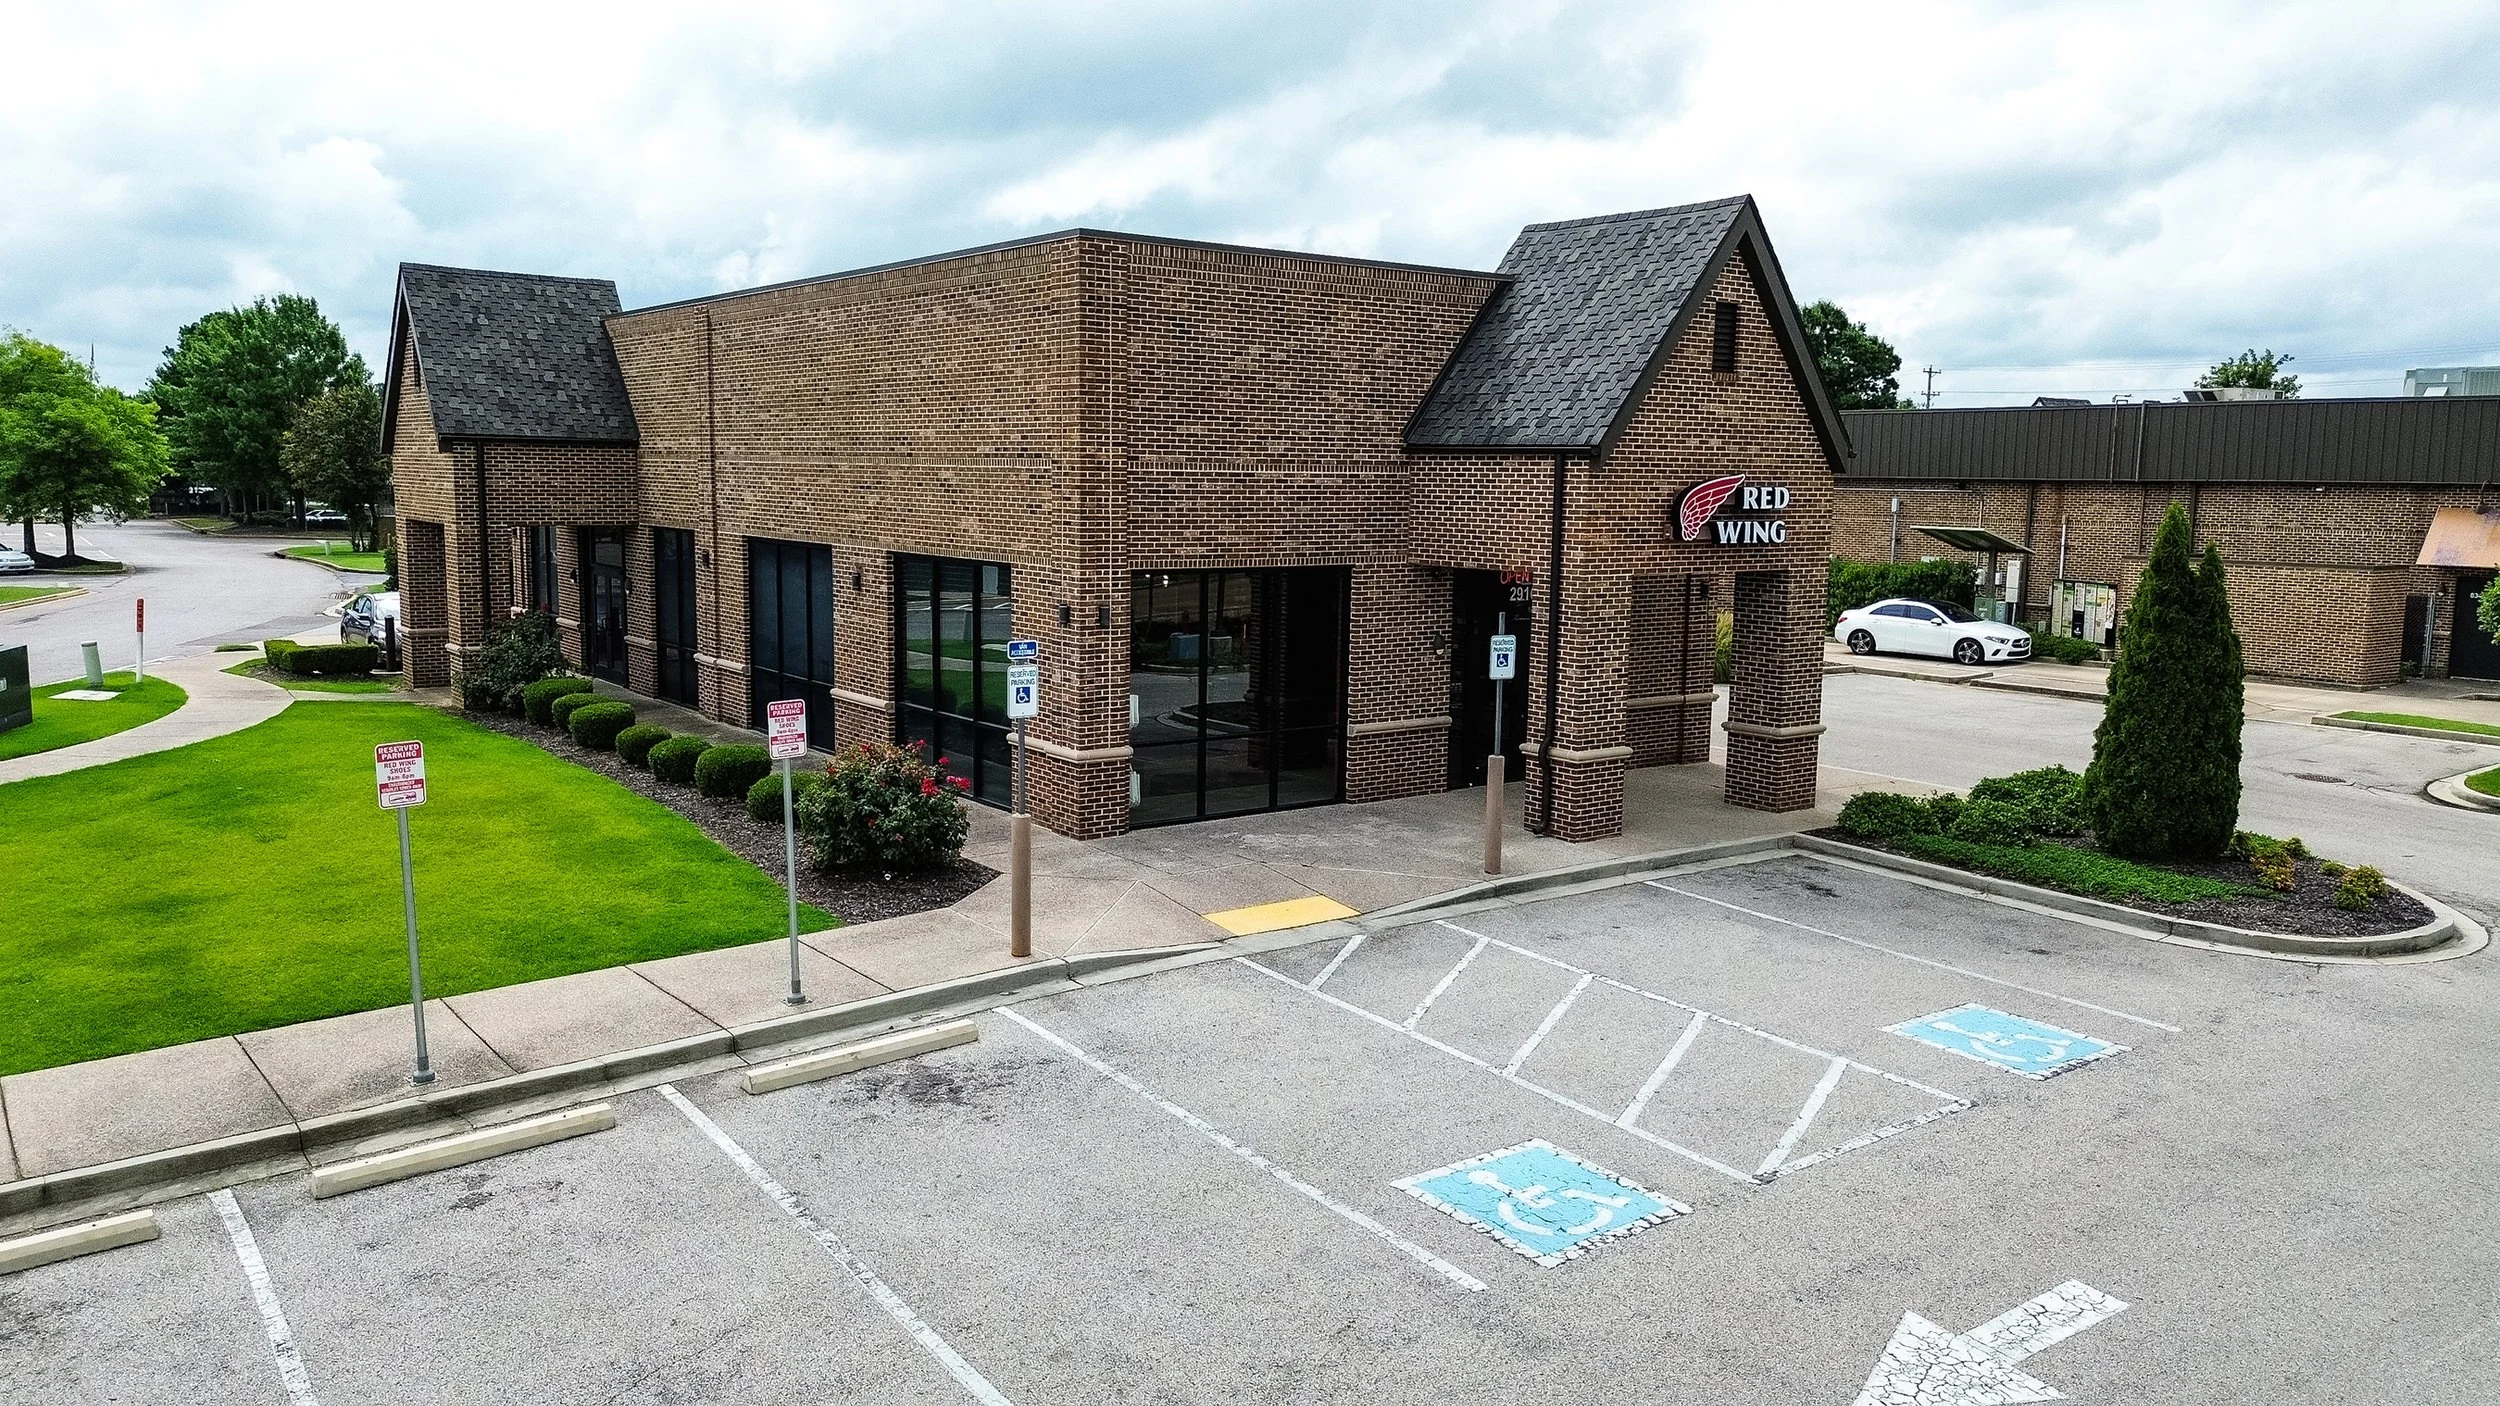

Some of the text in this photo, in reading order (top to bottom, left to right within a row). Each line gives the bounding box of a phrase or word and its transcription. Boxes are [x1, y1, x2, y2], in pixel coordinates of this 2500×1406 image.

[1743, 487, 1790, 509] RED
[1716, 520, 1786, 544] WING
[1500, 570, 1530, 584] OPEN
[1010, 670, 1036, 678] RESERVED
[770, 702, 802, 711] RESERVED
[773, 708, 801, 716] PARKING
[378, 744, 420, 754] RESERVED
[382, 750, 417, 760] PARKING
